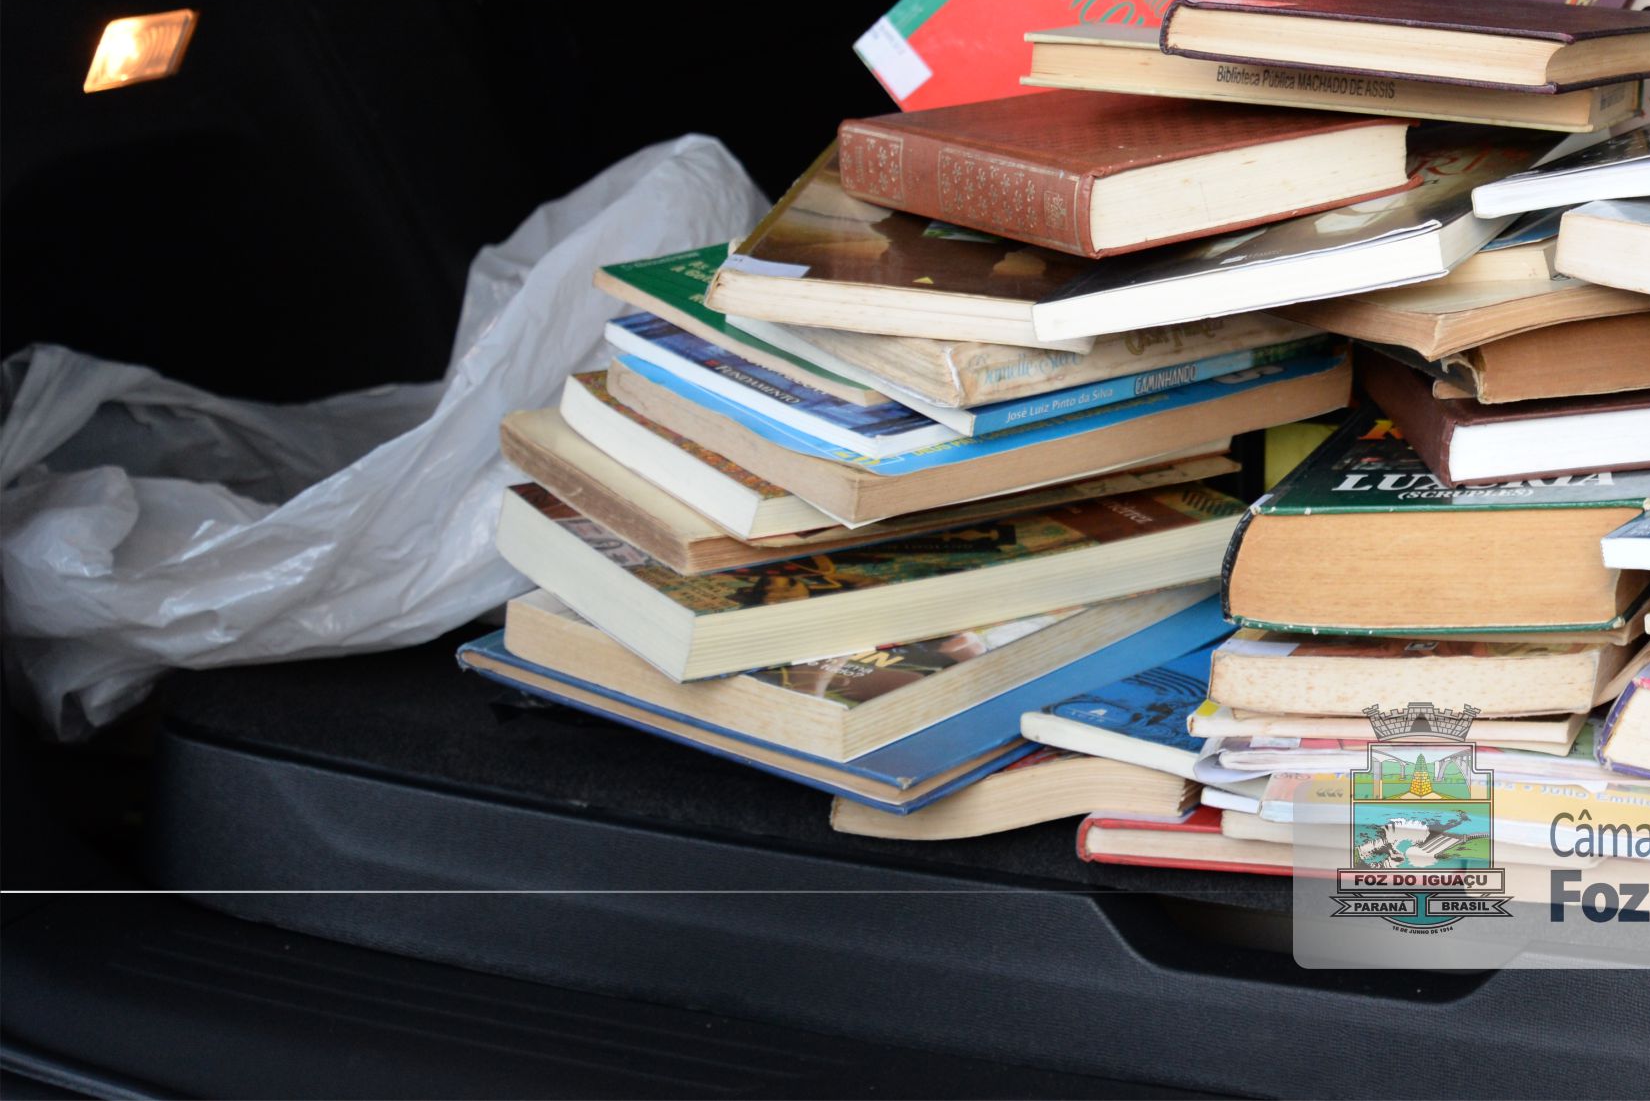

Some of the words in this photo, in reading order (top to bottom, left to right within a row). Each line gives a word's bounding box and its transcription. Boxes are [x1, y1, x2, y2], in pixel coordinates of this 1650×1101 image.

[1216, 65, 1261, 87] Biblioteca
[1261, 69, 1296, 90] Pública
[1298, 73, 1351, 95] MACHADO
[1350, 78, 1365, 96] DE
[1364, 80, 1396, 99] ASSIS
[716, 364, 800, 404] FUNDAMENTO
[1006, 407, 1028, 424] José
[1030, 402, 1050, 417] Luiz
[1052, 396, 1077, 411] Pinto
[1078, 393, 1091, 405] da
[1092, 387, 1114, 402] Silva
[1134, 362, 1199, 395] CAMINHANDO
